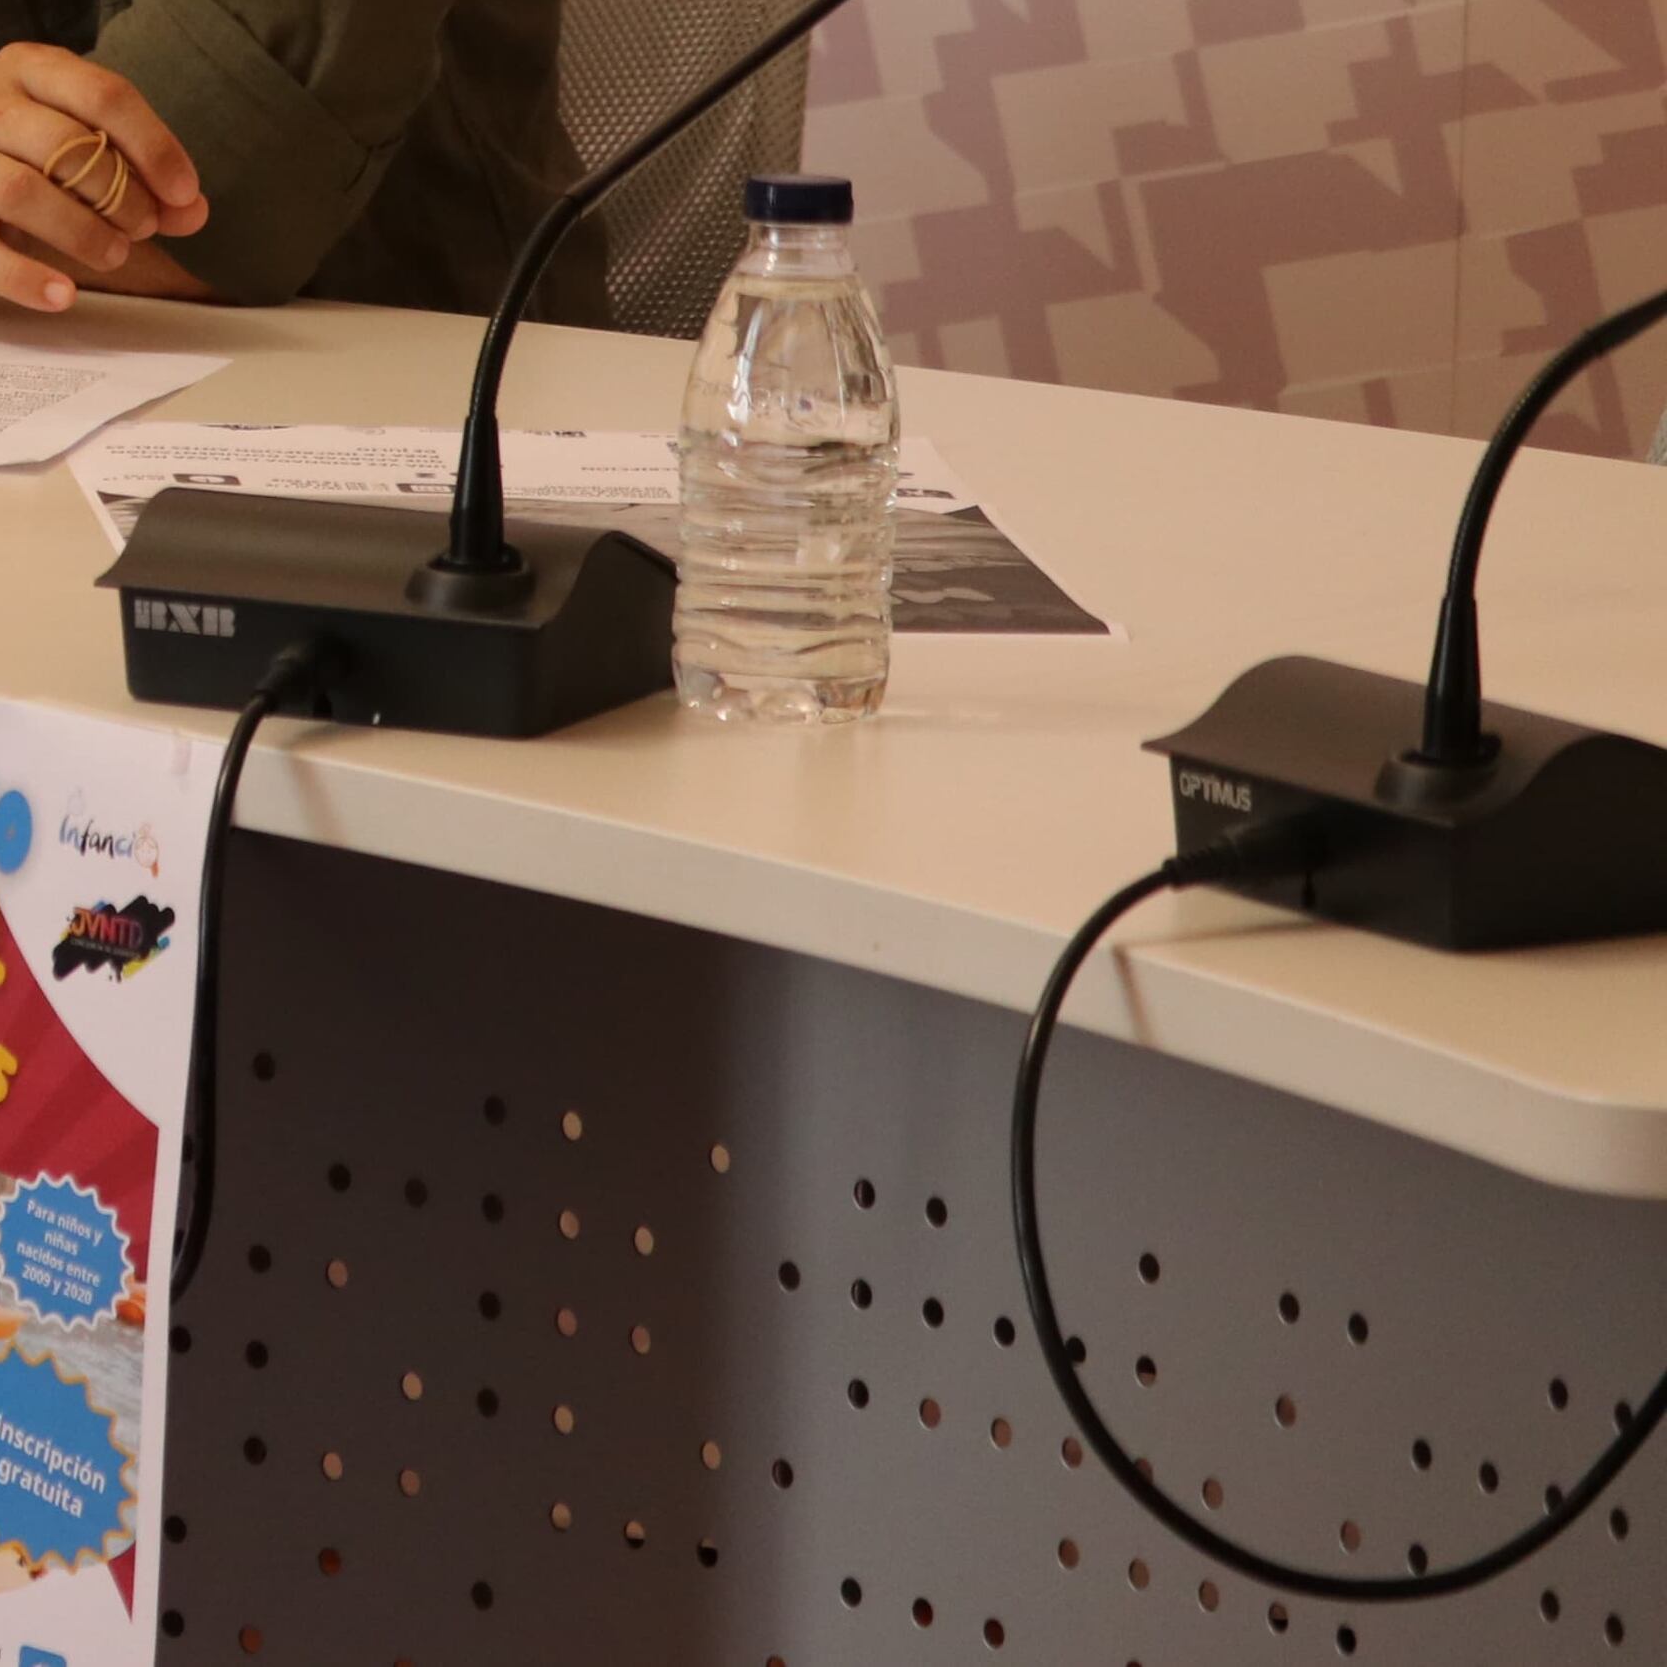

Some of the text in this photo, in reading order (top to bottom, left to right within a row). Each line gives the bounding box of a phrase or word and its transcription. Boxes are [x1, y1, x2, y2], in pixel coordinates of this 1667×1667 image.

[27, 1199, 103, 1246] Para niños y
[44, 1230, 79, 1256] niñas
[16, 1241, 100, 1287] nacidos entre
[22, 1264, 92, 1306] 2009 y 2020
